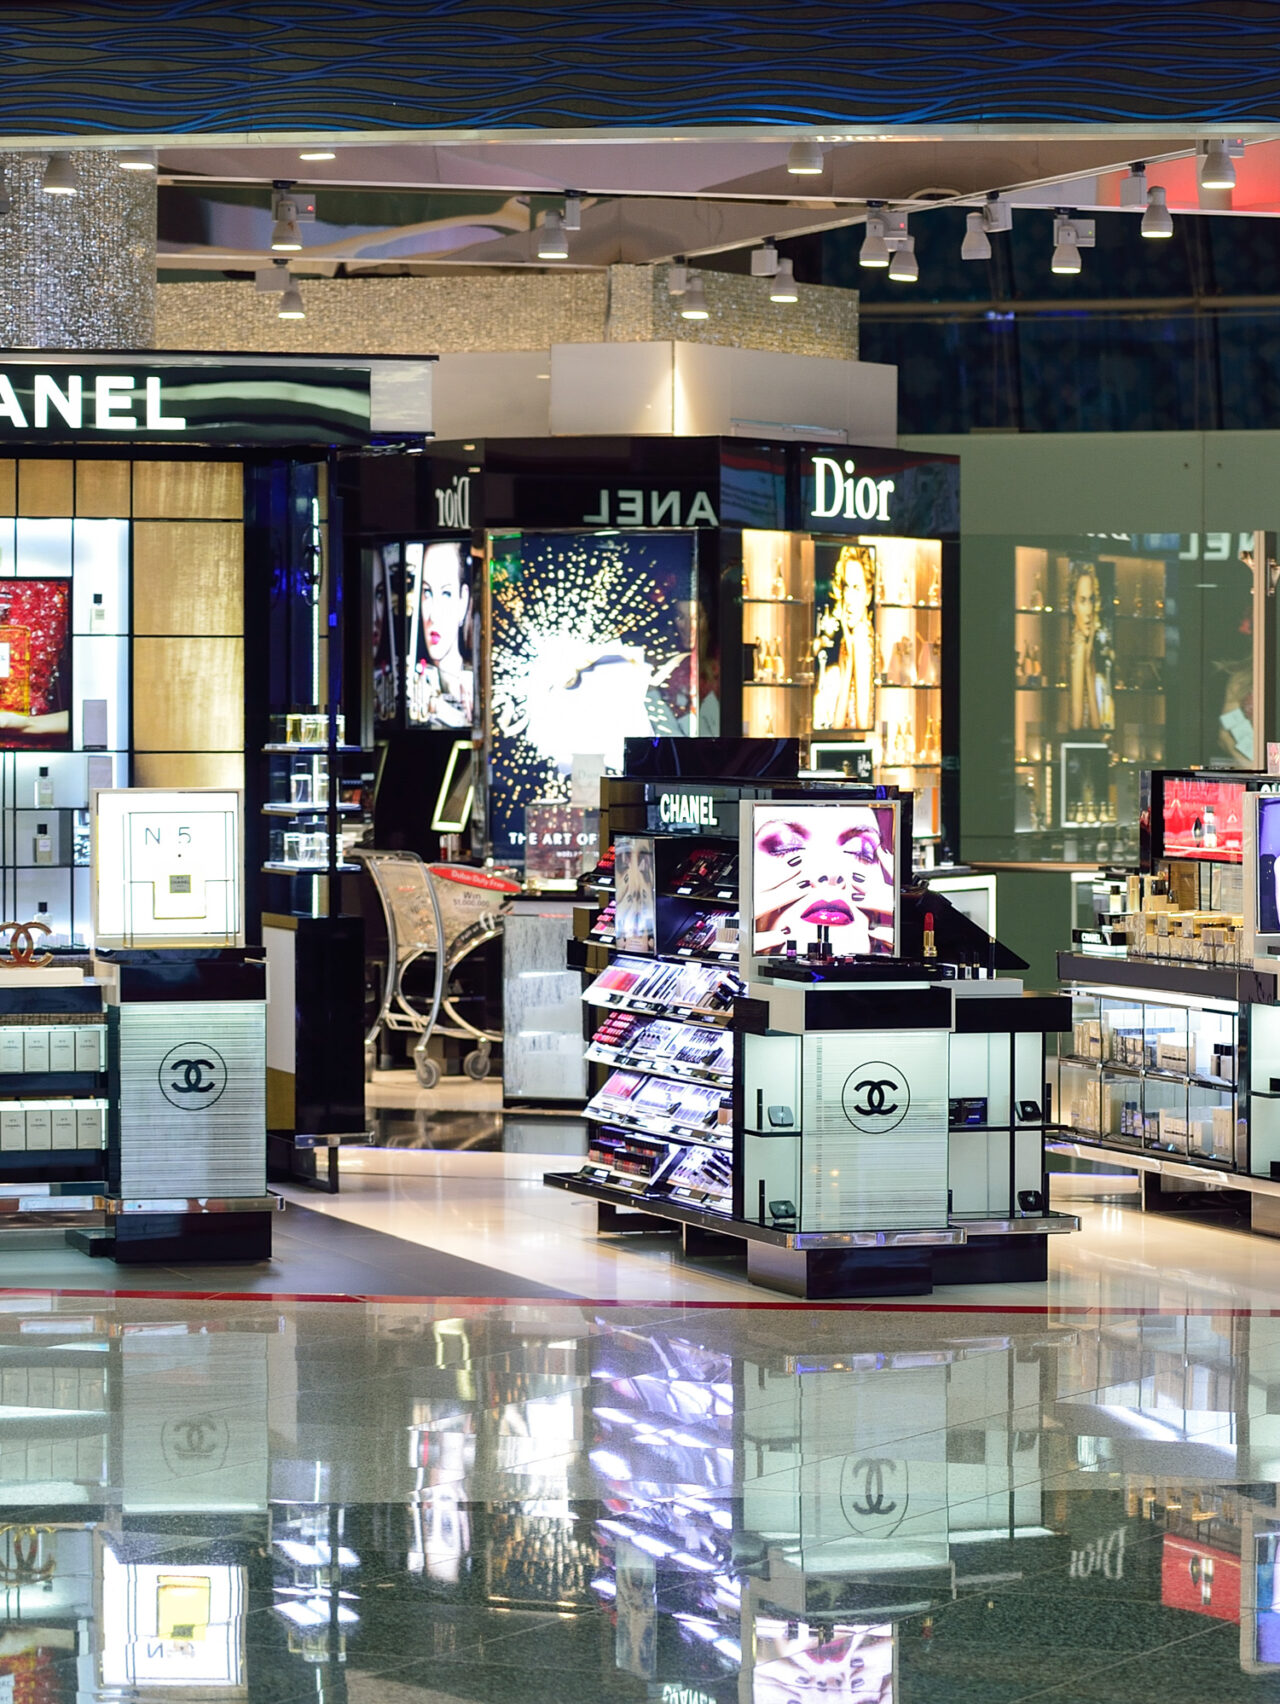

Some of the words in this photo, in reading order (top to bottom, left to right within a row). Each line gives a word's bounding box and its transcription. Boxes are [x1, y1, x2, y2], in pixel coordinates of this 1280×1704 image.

[811, 456, 895, 522] Dior
[659, 793, 718, 826] CHANEL
[508, 831, 538, 846] THE
[542, 832, 573, 846] ART
[576, 832, 599, 846] OF
